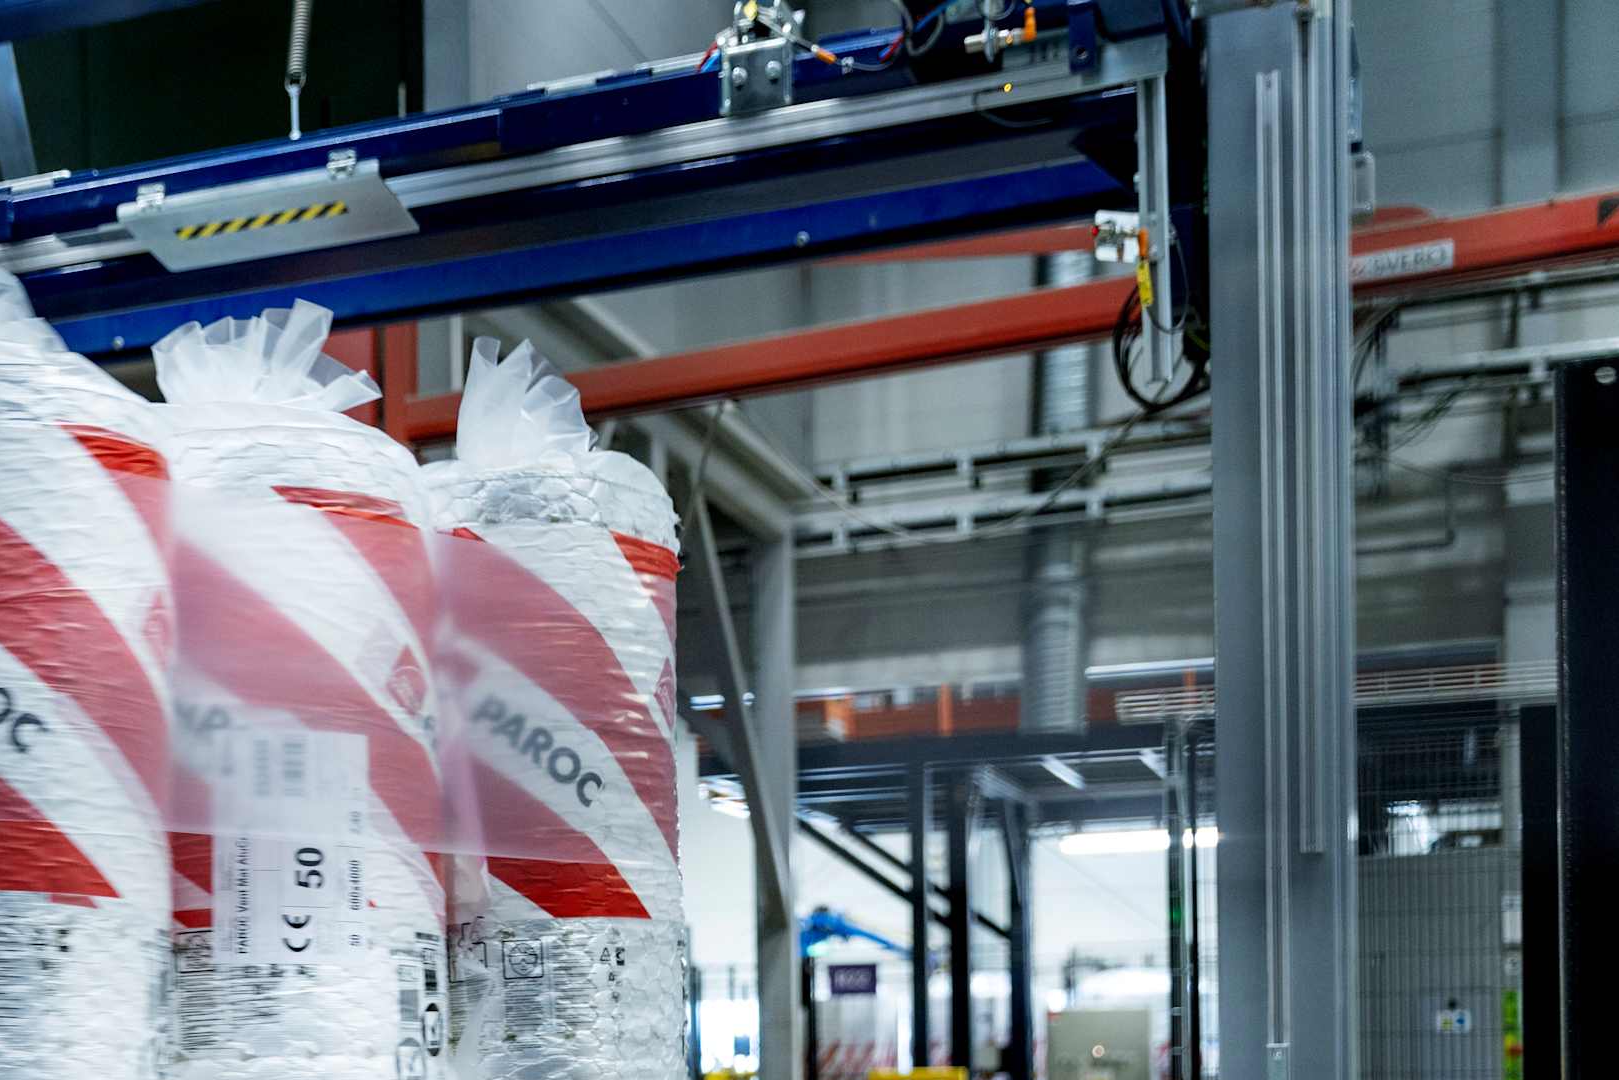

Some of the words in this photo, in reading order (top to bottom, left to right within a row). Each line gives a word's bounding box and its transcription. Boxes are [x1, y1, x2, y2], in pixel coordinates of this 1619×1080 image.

[470, 691, 605, 808] PAROC
[235, 867, 249, 887] Mat
[293, 846, 325, 889] 50
